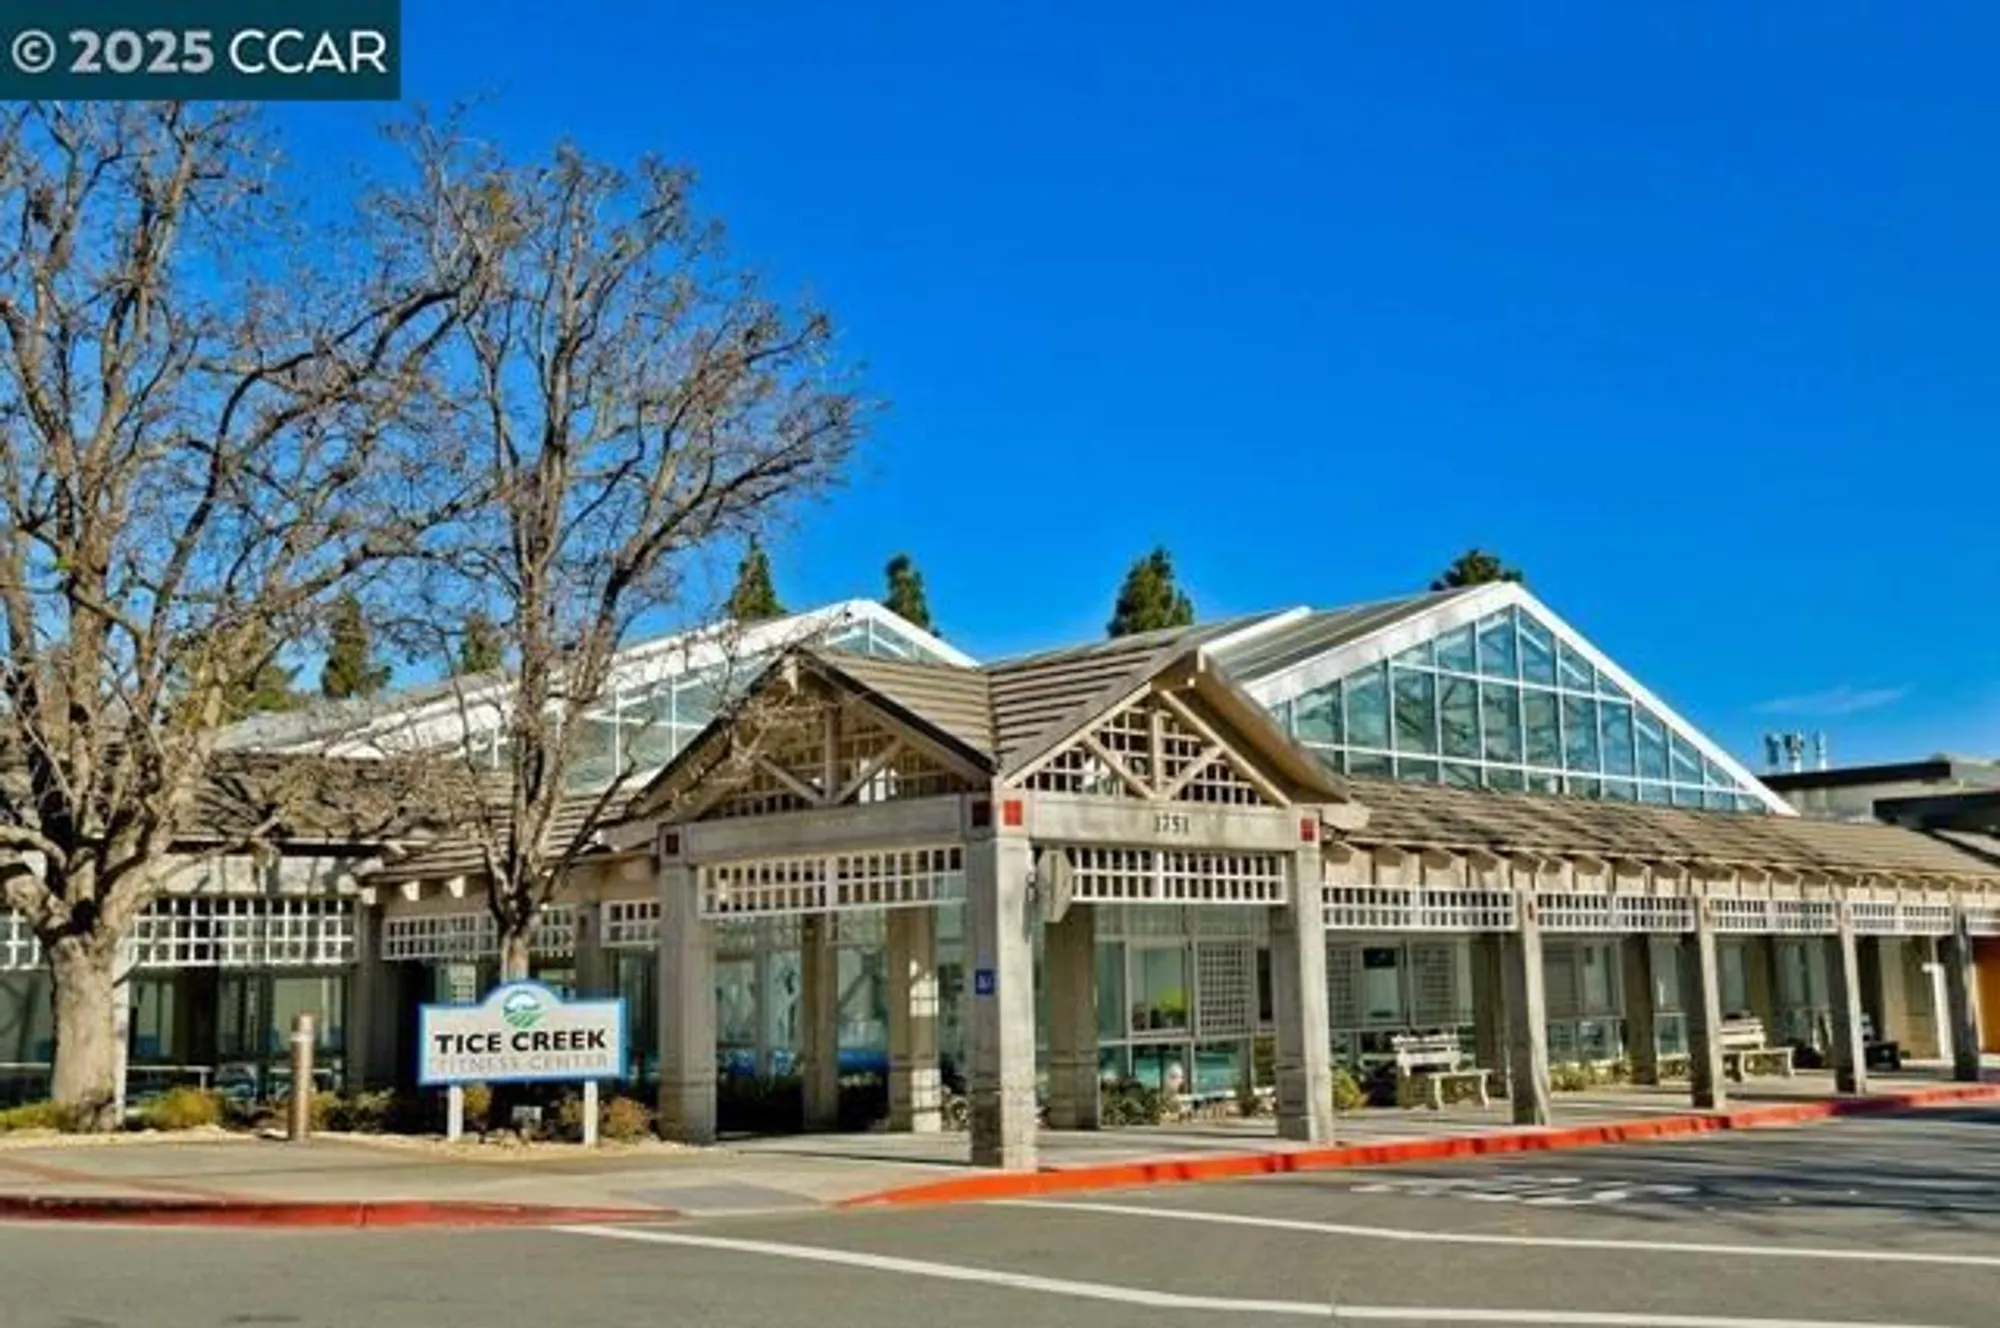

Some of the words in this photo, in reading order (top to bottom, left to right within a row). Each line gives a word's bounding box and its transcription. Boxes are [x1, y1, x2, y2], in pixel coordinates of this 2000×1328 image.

[434, 1032, 502, 1054] TICE
[511, 1029, 607, 1051] CREEK
[529, 1053, 608, 1072] CENTER
